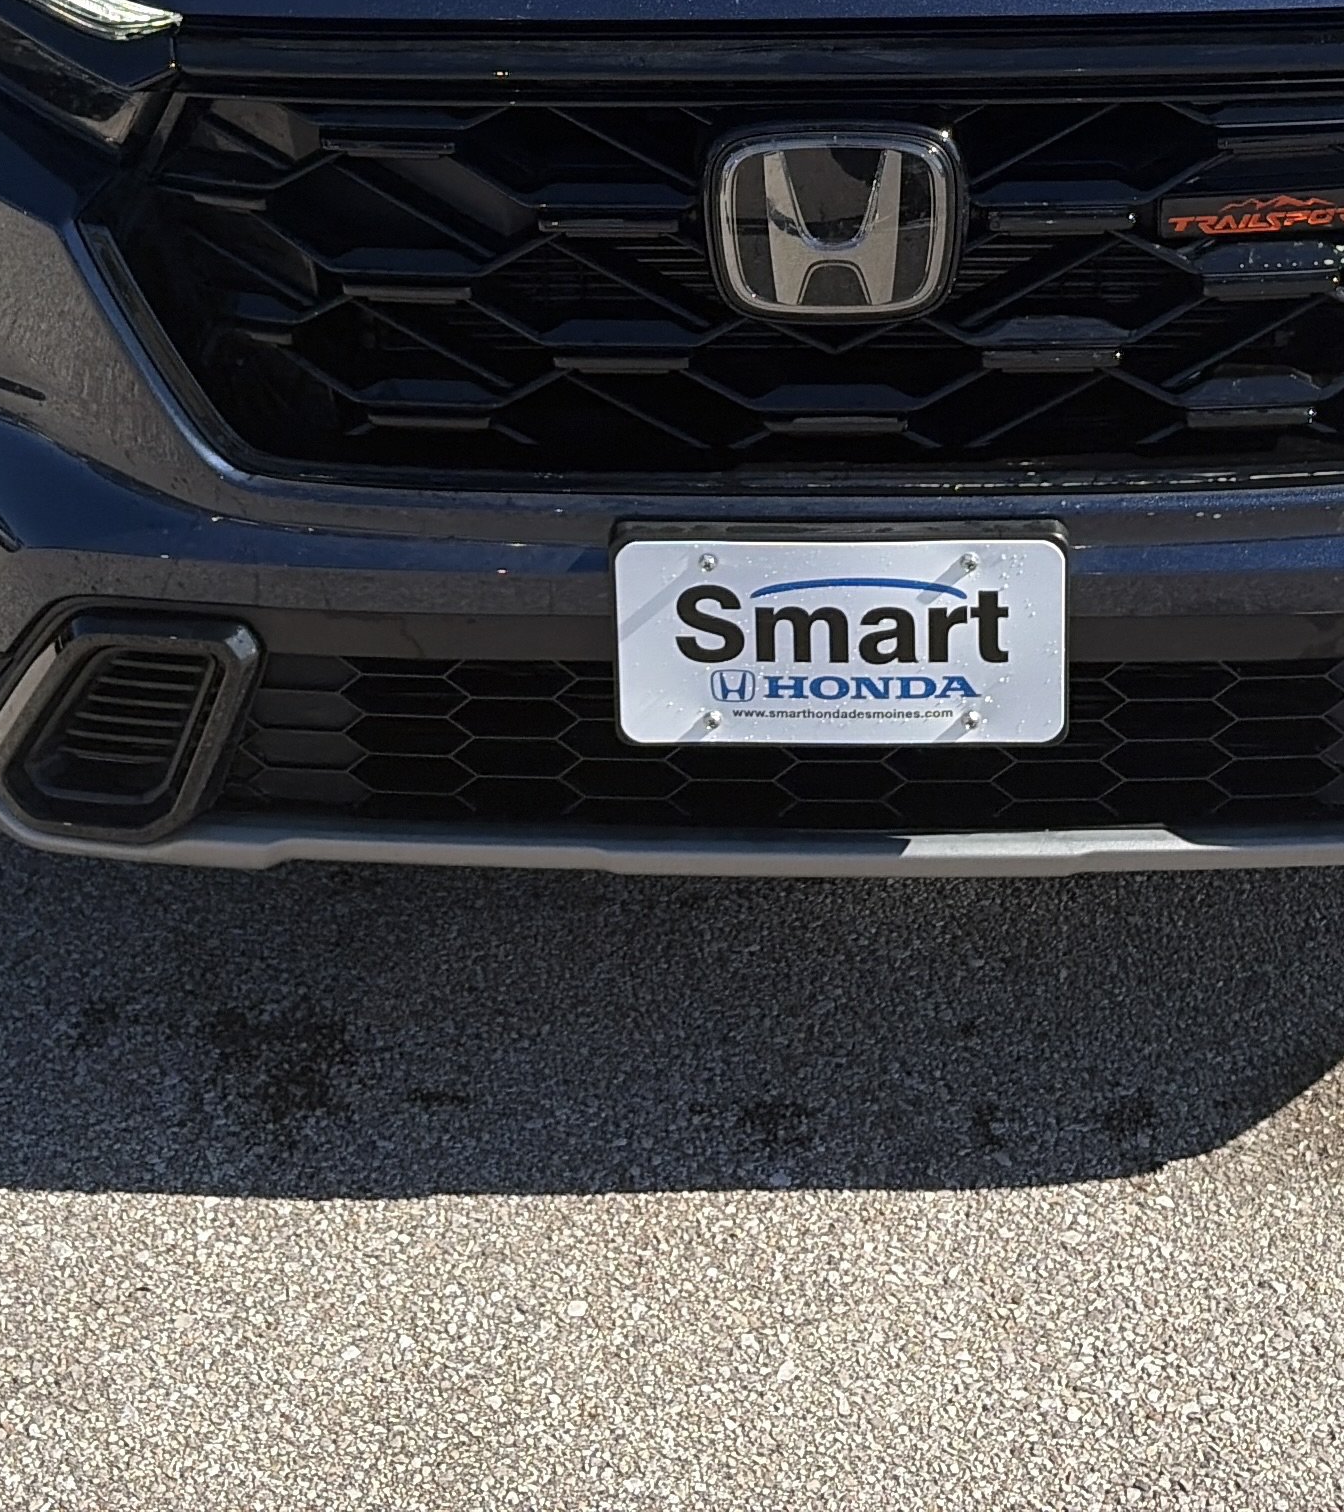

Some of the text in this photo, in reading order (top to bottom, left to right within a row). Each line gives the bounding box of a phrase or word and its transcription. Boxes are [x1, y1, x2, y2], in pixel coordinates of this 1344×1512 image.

[675, 584, 1010, 665] Smart
[763, 674, 982, 700] HONDA
[732, 706, 954, 720] www.smarthondadesmoines.com
